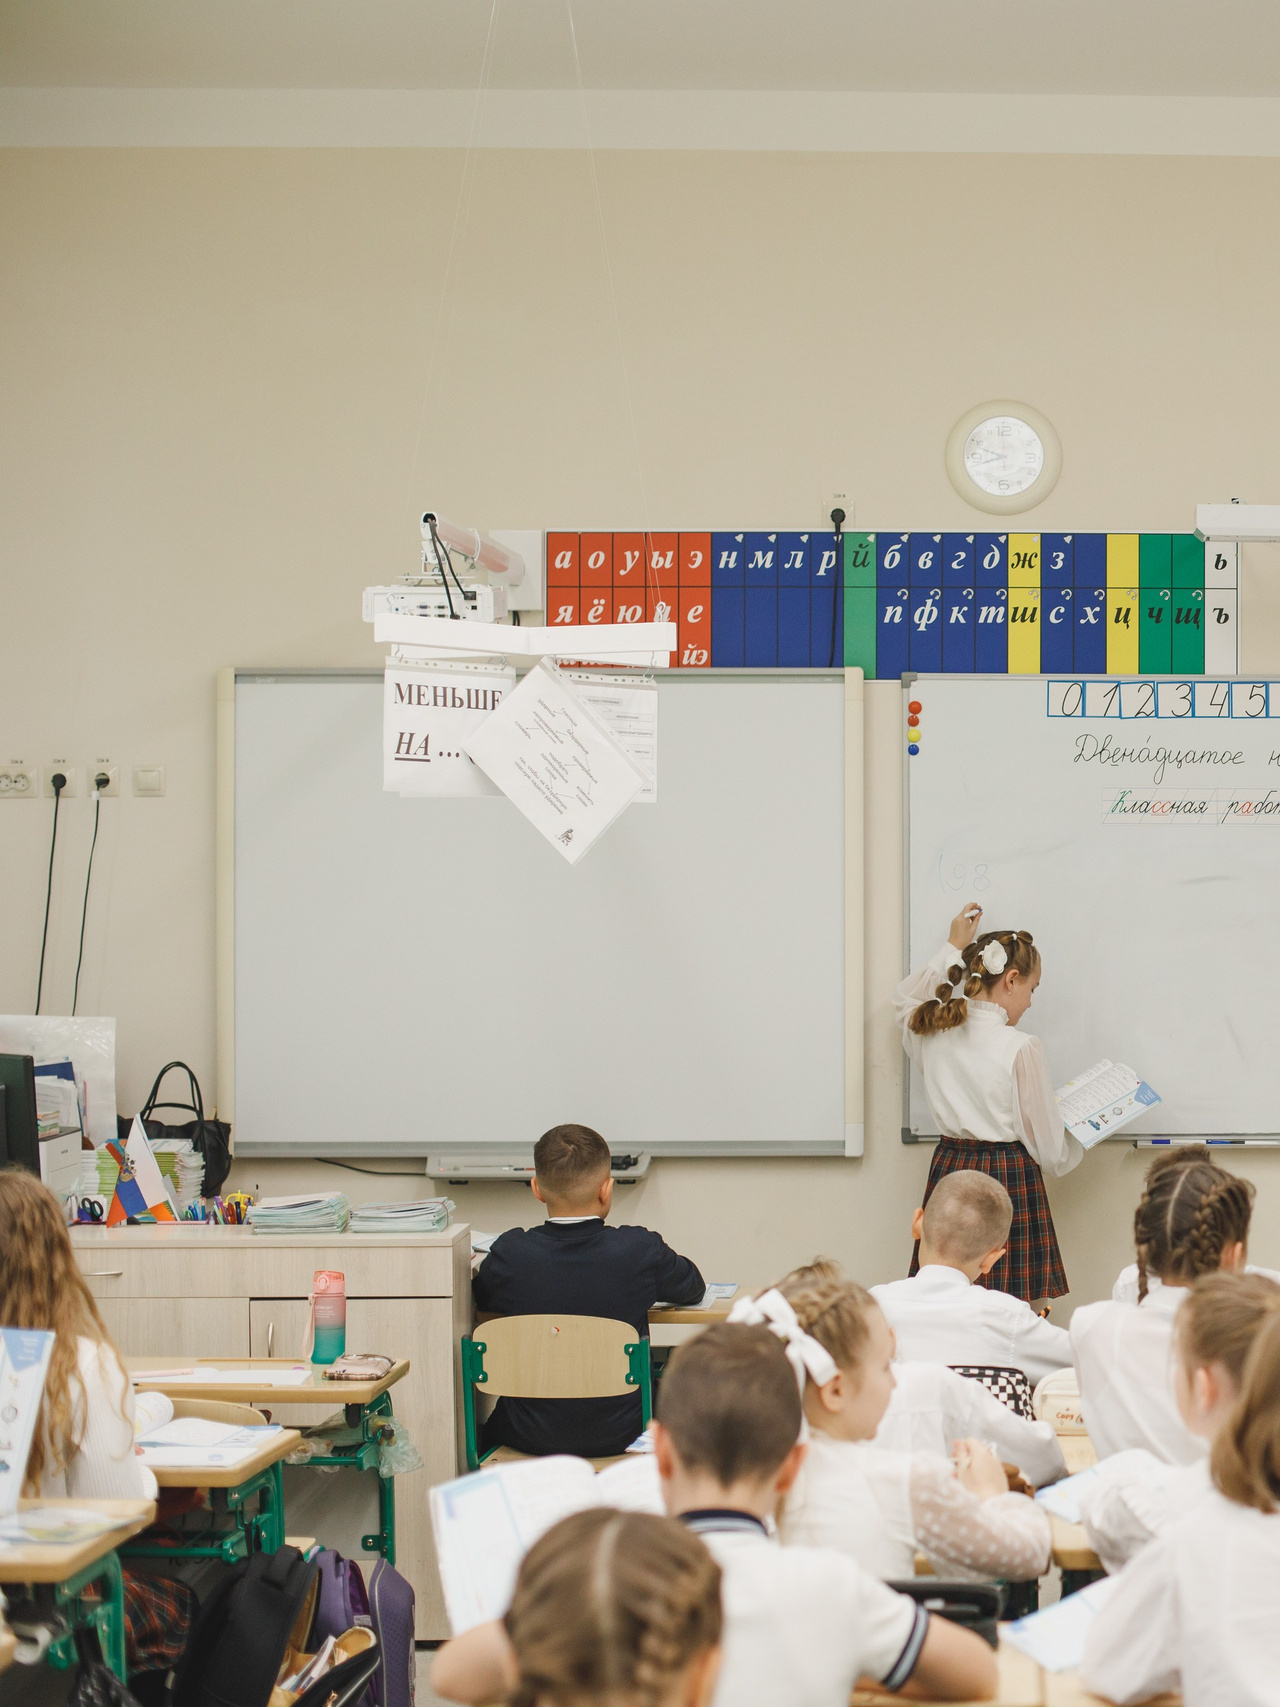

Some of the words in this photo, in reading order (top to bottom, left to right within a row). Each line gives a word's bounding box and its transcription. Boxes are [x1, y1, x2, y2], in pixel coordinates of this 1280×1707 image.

[996, 426, 1012, 436] 12
[971, 452, 982, 463] 9
[1025, 453, 1036, 463] 3
[998, 479, 1010, 490] 6
[555, 549, 572, 569] а
[588, 549, 606, 569] о
[619, 550, 640, 575] у
[651, 549, 674, 569] ы
[688, 549, 702, 569] э
[719, 549, 737, 569] н
[748, 549, 774, 569] м
[784, 549, 803, 569] л
[817, 549, 837, 576] р
[851, 543, 871, 569] й
[883, 544, 902, 569] б
[918, 550, 933, 569] в
[951, 550, 965, 569] г
[982, 544, 1001, 570] д
[1011, 550, 1039, 570] ж
[1050, 550, 1065, 570] з
[1214, 553, 1228, 571] ь
[554, 605, 573, 623] я
[588, 598, 605, 623] ё
[617, 605, 642, 623] ю
[688, 604, 703, 623] е
[884, 604, 902, 624] п
[913, 599, 938, 631] ф
[950, 604, 967, 624] к
[978, 604, 1004, 624] т
[1011, 604, 1038, 624] ш
[1049, 604, 1065, 624] с
[1079, 604, 1101, 624] х
[1114, 605, 1131, 630] ц
[1148, 605, 1163, 624] ч
[1174, 605, 1201, 630] щ
[1213, 605, 1230, 624] ъ
[394, 682, 503, 711] МЕНЬШЕ
[1061, 682, 1083, 717] 0
[1102, 683, 1120, 717] 1
[1134, 683, 1156, 718] 2
[1171, 683, 1192, 717] 3
[1209, 683, 1229, 717] 4
[1245, 683, 1266, 717] 5
[537, 698, 556, 718] ударные
[560, 708, 578, 727] Гласные
[514, 720, 532, 740] словарь
[395, 731, 430, 756] НА
[540, 753, 569, 784] однокоренные
[544, 766, 558, 780] слова
[547, 752, 570, 776] подобрать
[571, 755, 599, 784] проверяемые
[544, 794, 564, 815] ударение
[576, 785, 595, 806] изменить
[1111, 789, 1208, 816] Классная
[1056, 1412, 1074, 1420] Copy
